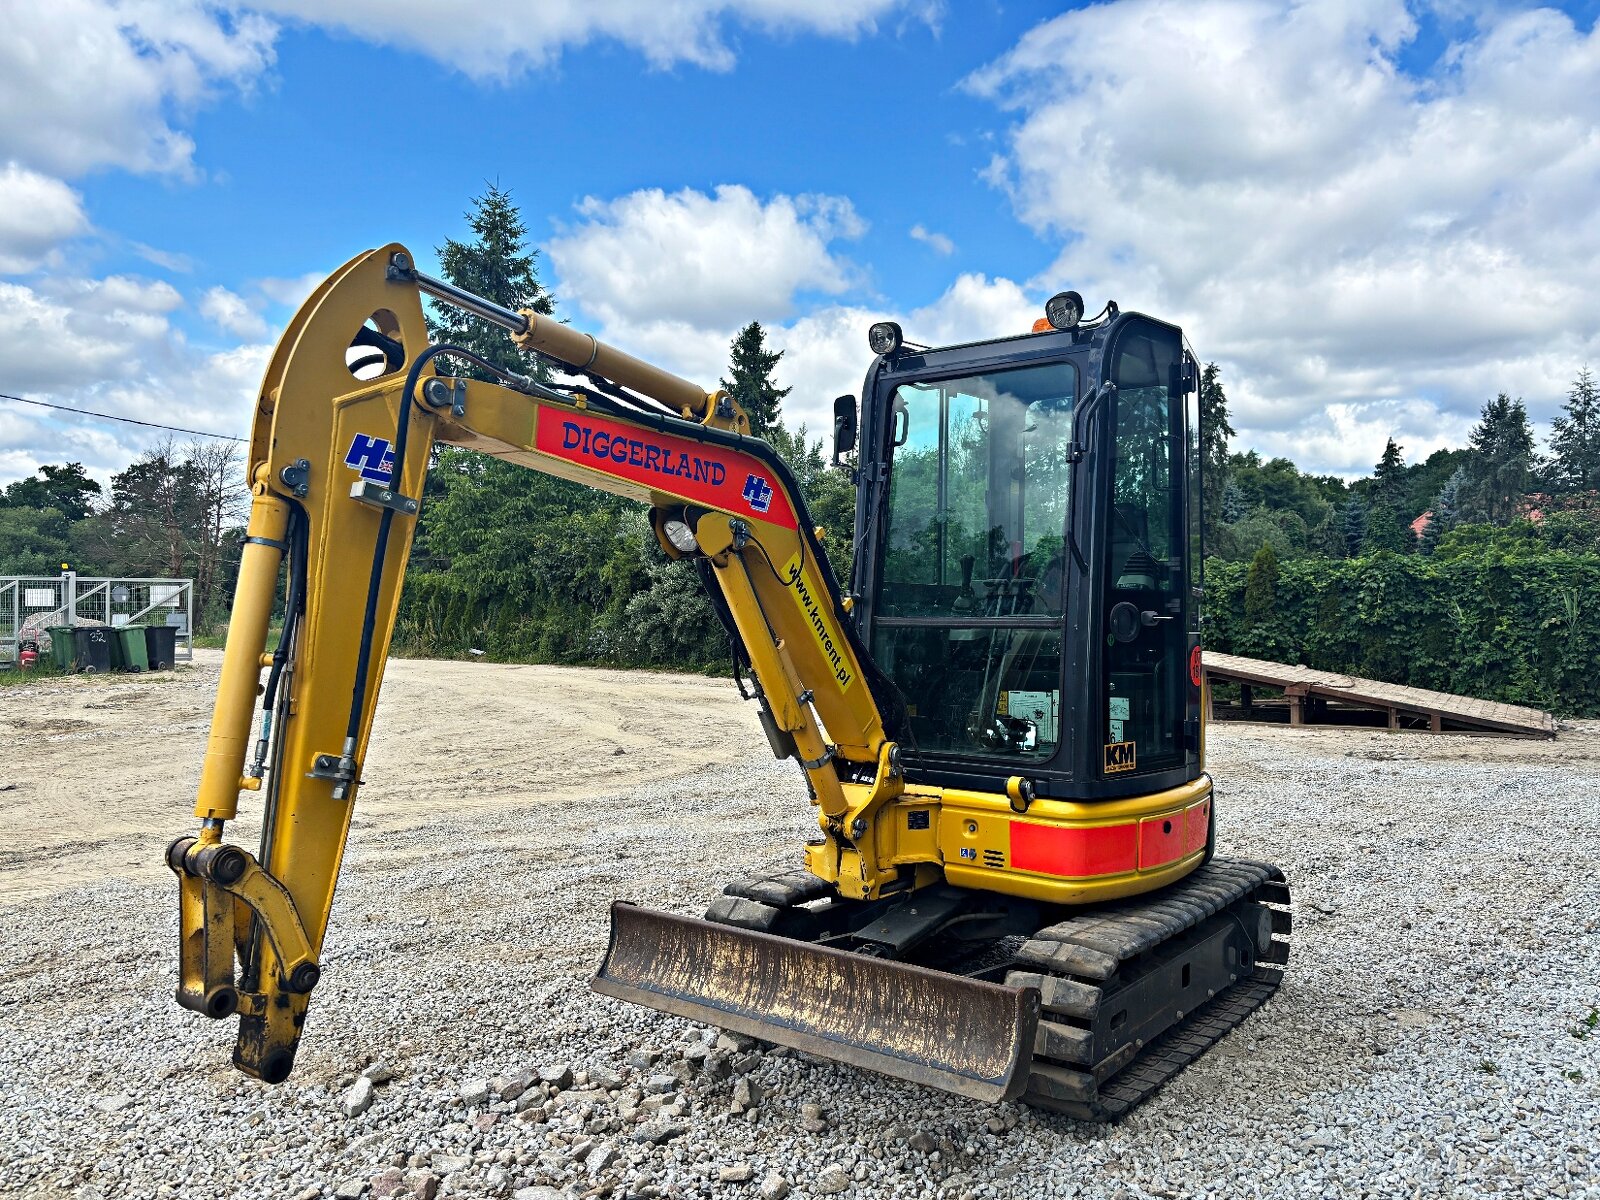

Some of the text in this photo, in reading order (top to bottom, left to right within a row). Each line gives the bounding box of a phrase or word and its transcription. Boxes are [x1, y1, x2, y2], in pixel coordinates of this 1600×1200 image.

[563, 422, 727, 486] DIGGERLAND
[789, 562, 851, 687] www.kmrent.pl
[1106, 743, 1134, 766] KM
